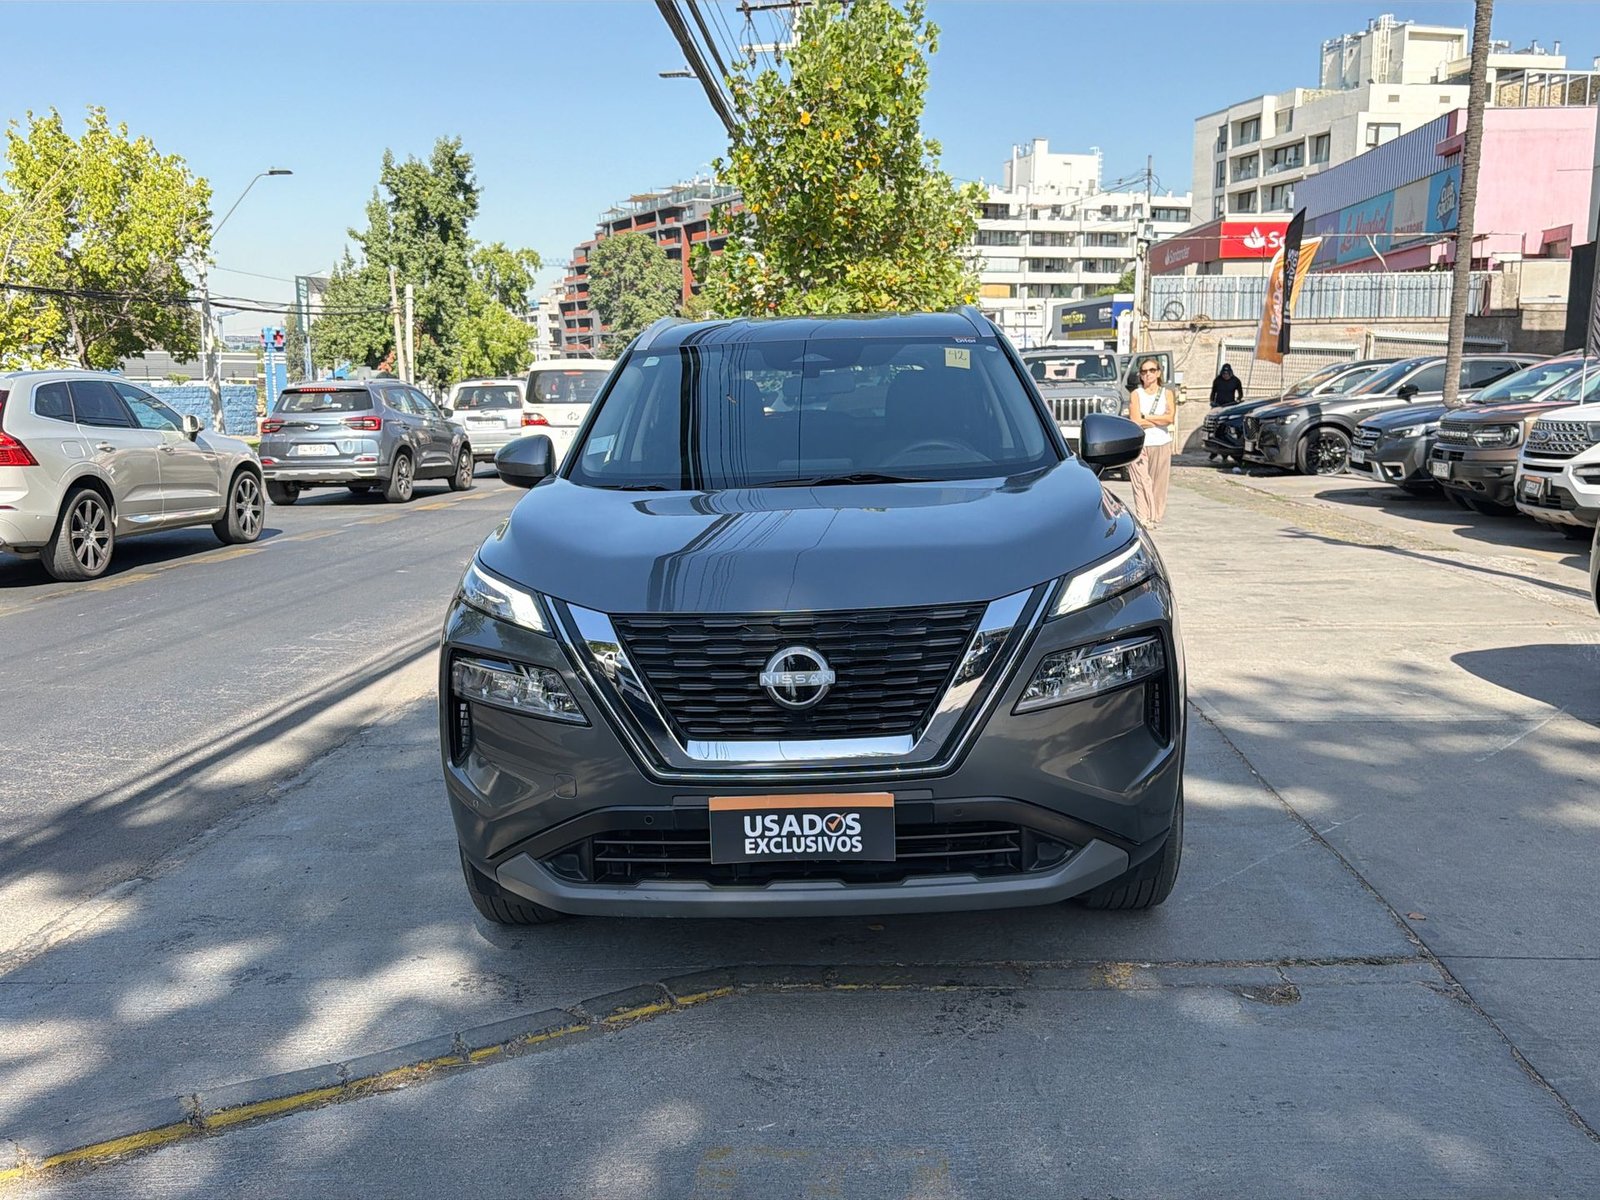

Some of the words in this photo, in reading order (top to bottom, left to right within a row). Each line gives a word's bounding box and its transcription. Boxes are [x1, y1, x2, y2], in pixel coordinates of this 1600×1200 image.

[761, 674, 833, 684] NISSAN
[743, 813, 862, 837] USADOS
[744, 836, 863, 855] EXCLUSIVOS
